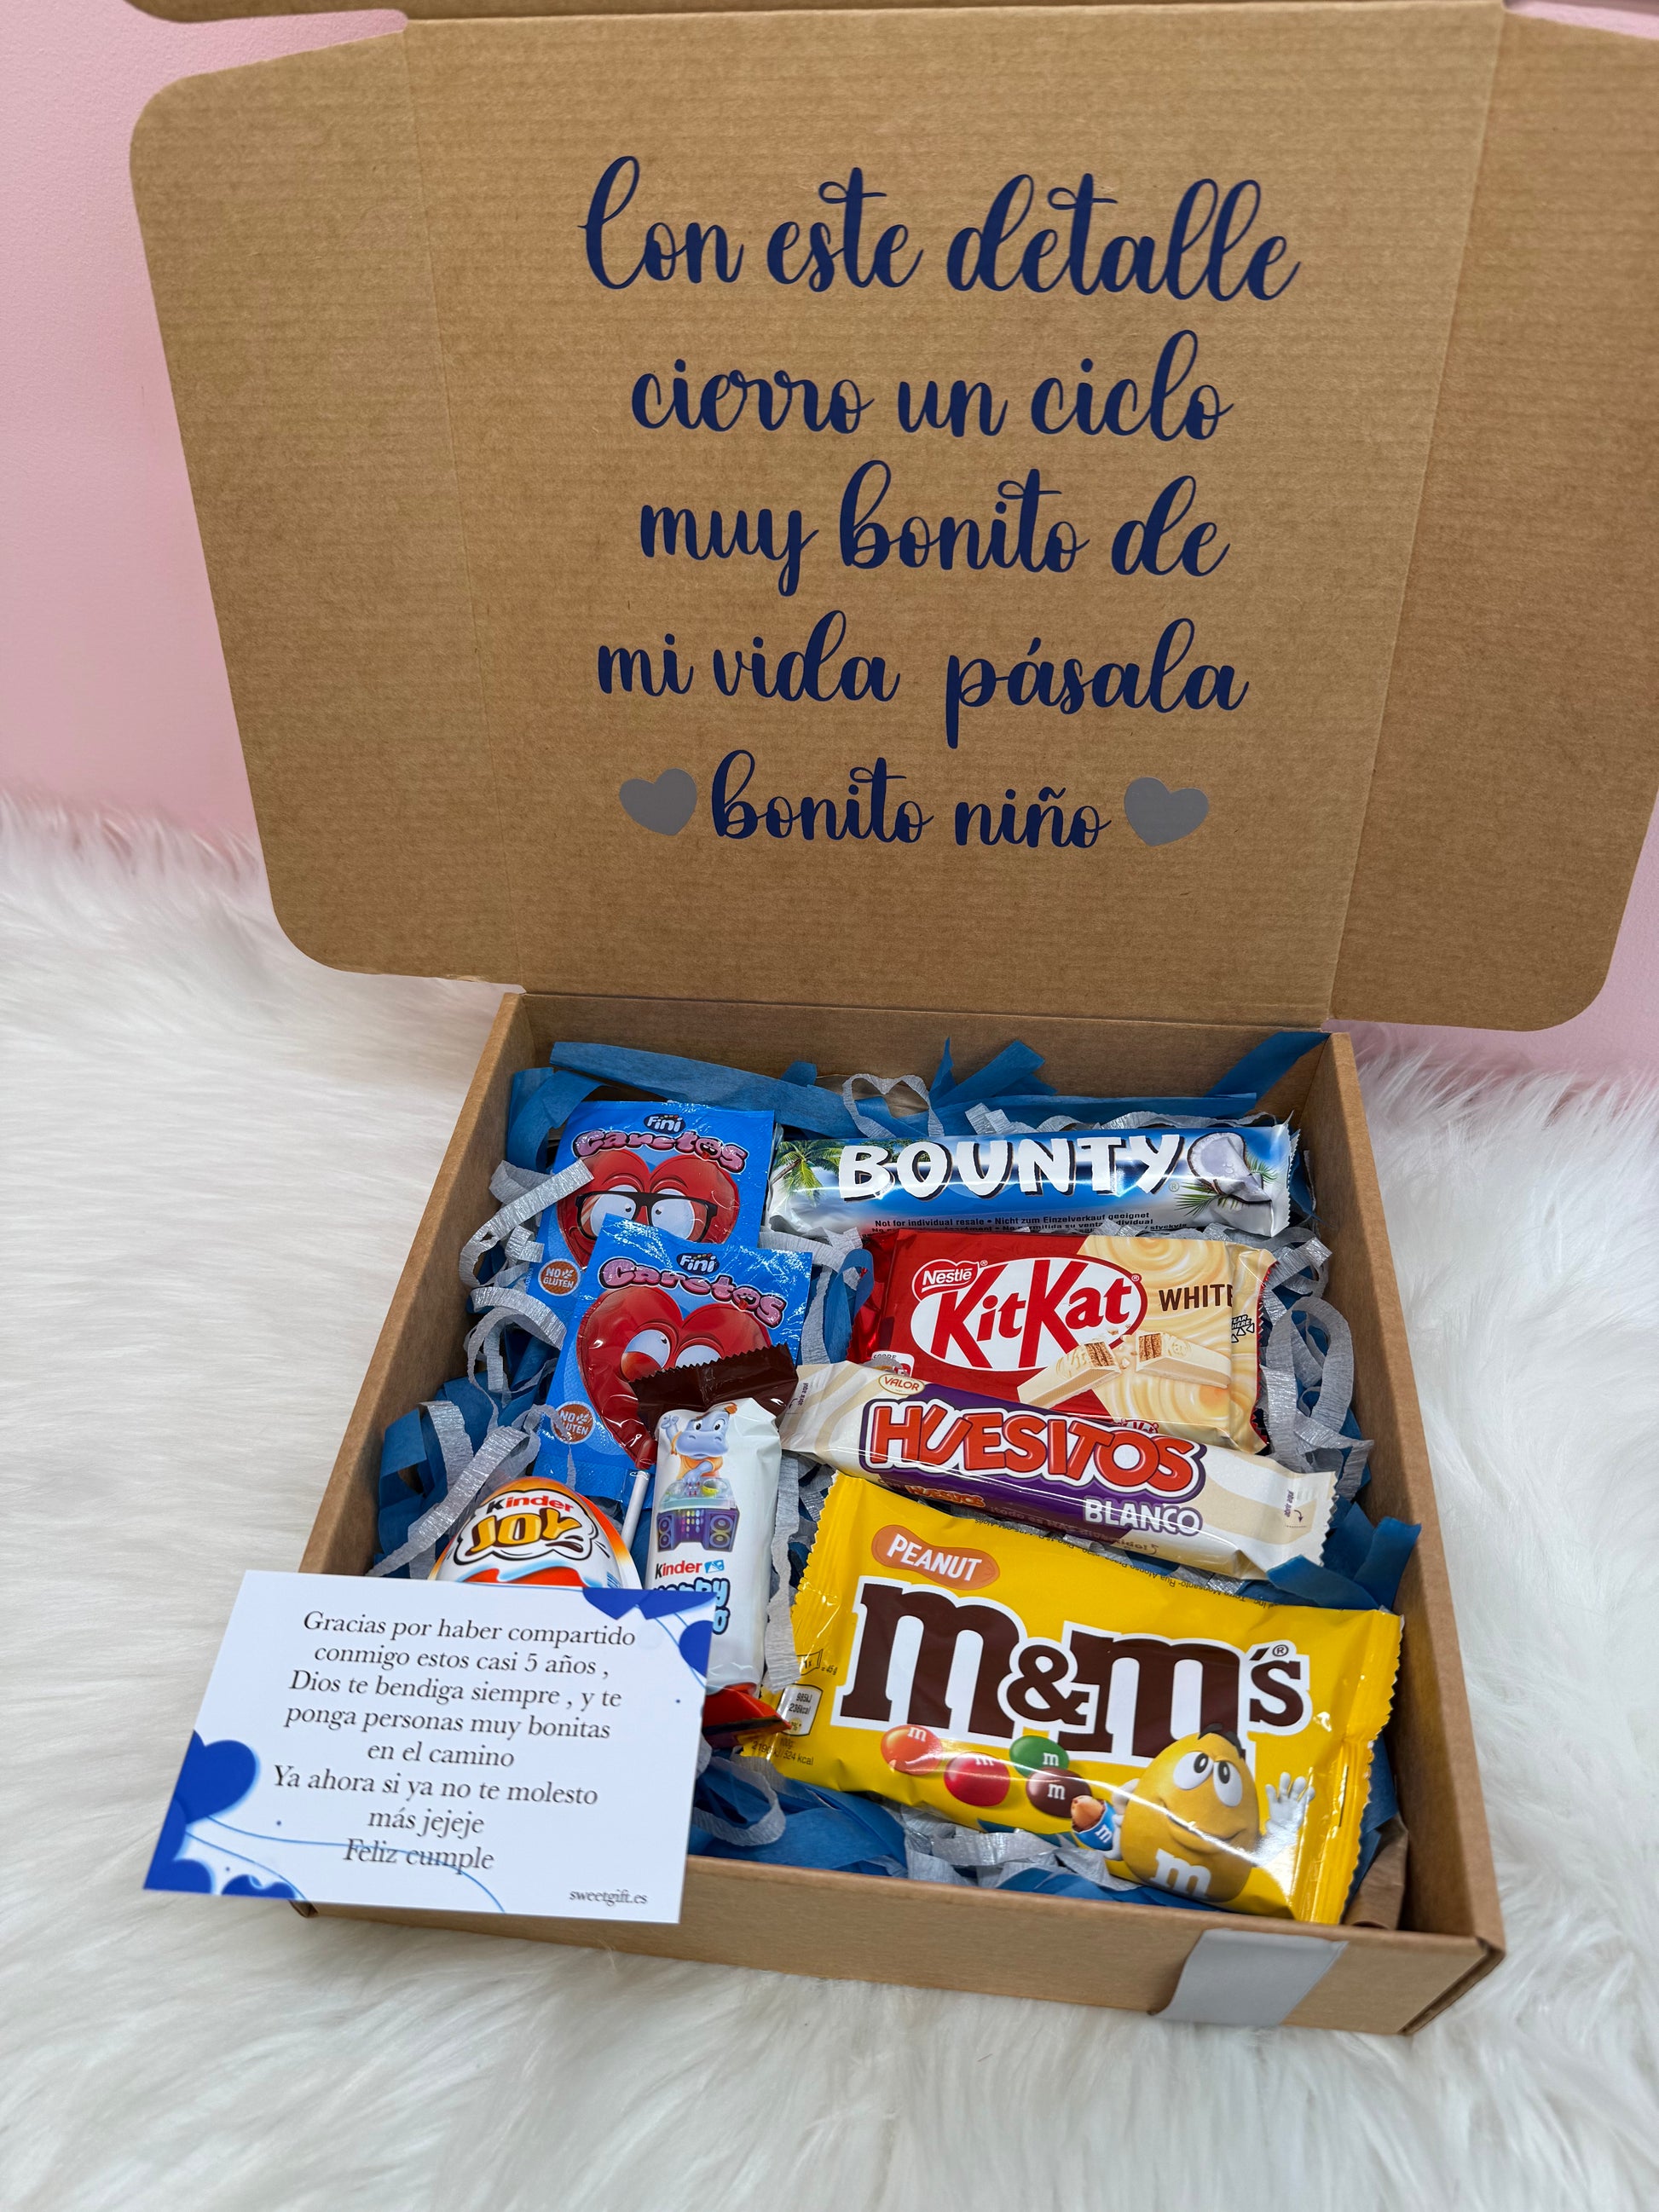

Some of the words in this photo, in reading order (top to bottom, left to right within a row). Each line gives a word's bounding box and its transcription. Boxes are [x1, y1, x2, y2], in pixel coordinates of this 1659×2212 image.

[766, 167, 923, 292] este
[946, 174, 1302, 302] detalle
[631, 358, 875, 435] cierro
[898, 380, 1009, 437] un
[1030, 330, 1234, 442] ciclo
[639, 504, 819, 597] muy
[840, 460, 1090, 574] bonito
[1110, 476, 1230, 577] de
[598, 634, 693, 696] mi
[713, 610, 899, 702] vida
[945, 618, 1249, 749] pásala
[711, 749, 934, 844] bonito
[954, 786, 1112, 849] niño
[646, 1114, 683, 1132] Fini
[838, 1134, 1185, 1202] BOUNTY
[908, 1218, 953, 1227] individual
[994, 1216, 1019, 1226] Nicht
[1043, 1214, 1106, 1223] Einzelverkauf
[1107, 1212, 1150, 1221] geeignet
[546, 1268, 561, 1278] NO
[679, 1255, 718, 1273] Fini
[543, 1277, 574, 1288] GLUTEN
[930, 1260, 1132, 1369] KitKat
[884, 1376, 920, 1391] VALOR
[559, 1410, 575, 1423] NO
[868, 1403, 1196, 1493] HUESITOS
[465, 1507, 583, 1556] JOY
[1085, 1499, 1200, 1535] BLANCO
[887, 1536, 982, 1582] PEANUT
[303, 1610, 386, 1634] Gracias
[390, 1621, 433, 1642] por
[436, 1618, 505, 1640] haber
[507, 1624, 636, 1649] compartido
[314, 1644, 410, 1671] conmigo
[416, 1652, 469, 1671] estos
[476, 1651, 517, 1672] casi
[523, 1652, 538, 1672] 5
[545, 1654, 597, 1676] años
[288, 1669, 341, 1694] Dios
[348, 1678, 369, 1695] te
[374, 1674, 464, 1706] bendiga
[471, 1680, 561, 1710] siempre
[580, 1692, 595, 1713] y
[602, 1690, 622, 1707] te
[283, 1707, 356, 1731] ponga
[361, 1712, 464, 1735] personas
[470, 1718, 522, 1741] muy
[528, 1714, 610, 1739] bonitas
[907, 1726, 927, 1742] m
[367, 1745, 395, 1761] en
[402, 1741, 423, 1762] el
[428, 1744, 515, 1767] camino
[1043, 1752, 1059, 1767] m
[274, 1764, 301, 1788] Ya
[307, 1768, 375, 1793] ahora
[382, 1772, 401, 1794] si
[405, 1778, 434, 1799] ya
[440, 1782, 471, 1799] no
[478, 1782, 500, 1800] te
[506, 1781, 598, 1805] molesto
[1048, 1783, 1065, 1800] m
[367, 1806, 416, 1829] más
[416, 1807, 485, 1839] jejeje
[1095, 1825, 1113, 1844] m
[343, 1838, 399, 1863] Feliz
[406, 1846, 494, 1875] cumple
[1151, 1848, 1212, 1899] m
[569, 1889, 648, 1907] sweetgift.es
